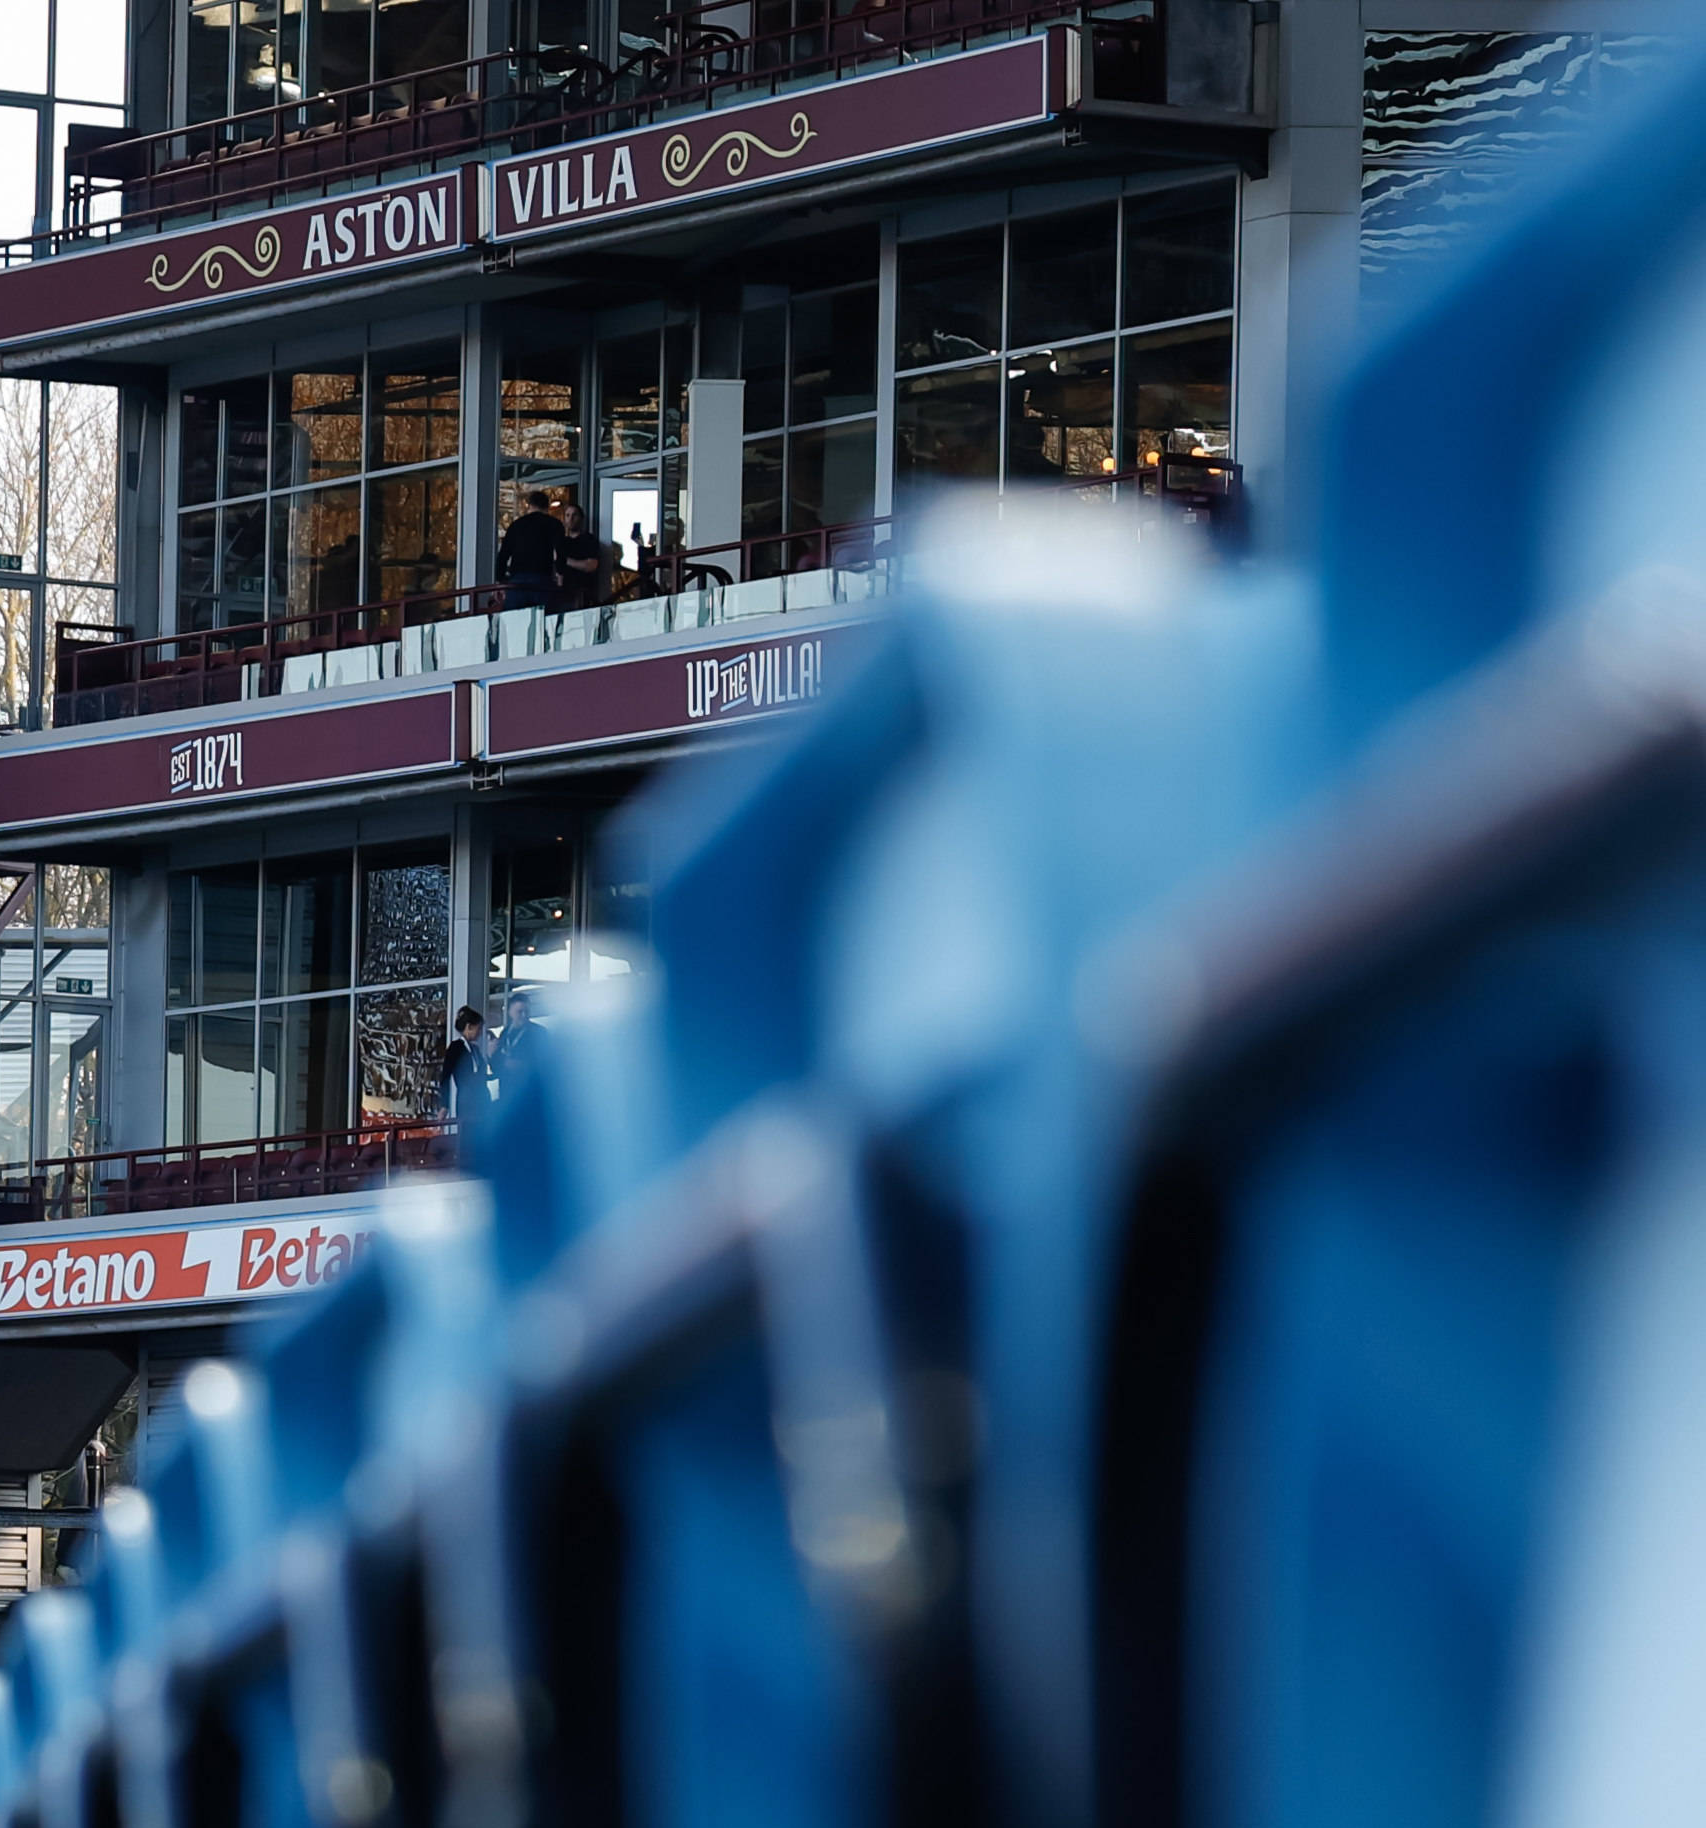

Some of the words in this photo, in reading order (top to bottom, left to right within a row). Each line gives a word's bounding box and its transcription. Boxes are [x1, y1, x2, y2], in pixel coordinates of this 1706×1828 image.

[302, 186, 447, 270] ASTON
[507, 145, 638, 225] VILLA
[686, 659, 719, 718] UP
[720, 661, 747, 703] THE
[748, 640, 822, 706] VILLA!
[171, 749, 192, 785] EST
[193, 732, 243, 791] 1874
[236, 1226, 378, 1290] Beta
